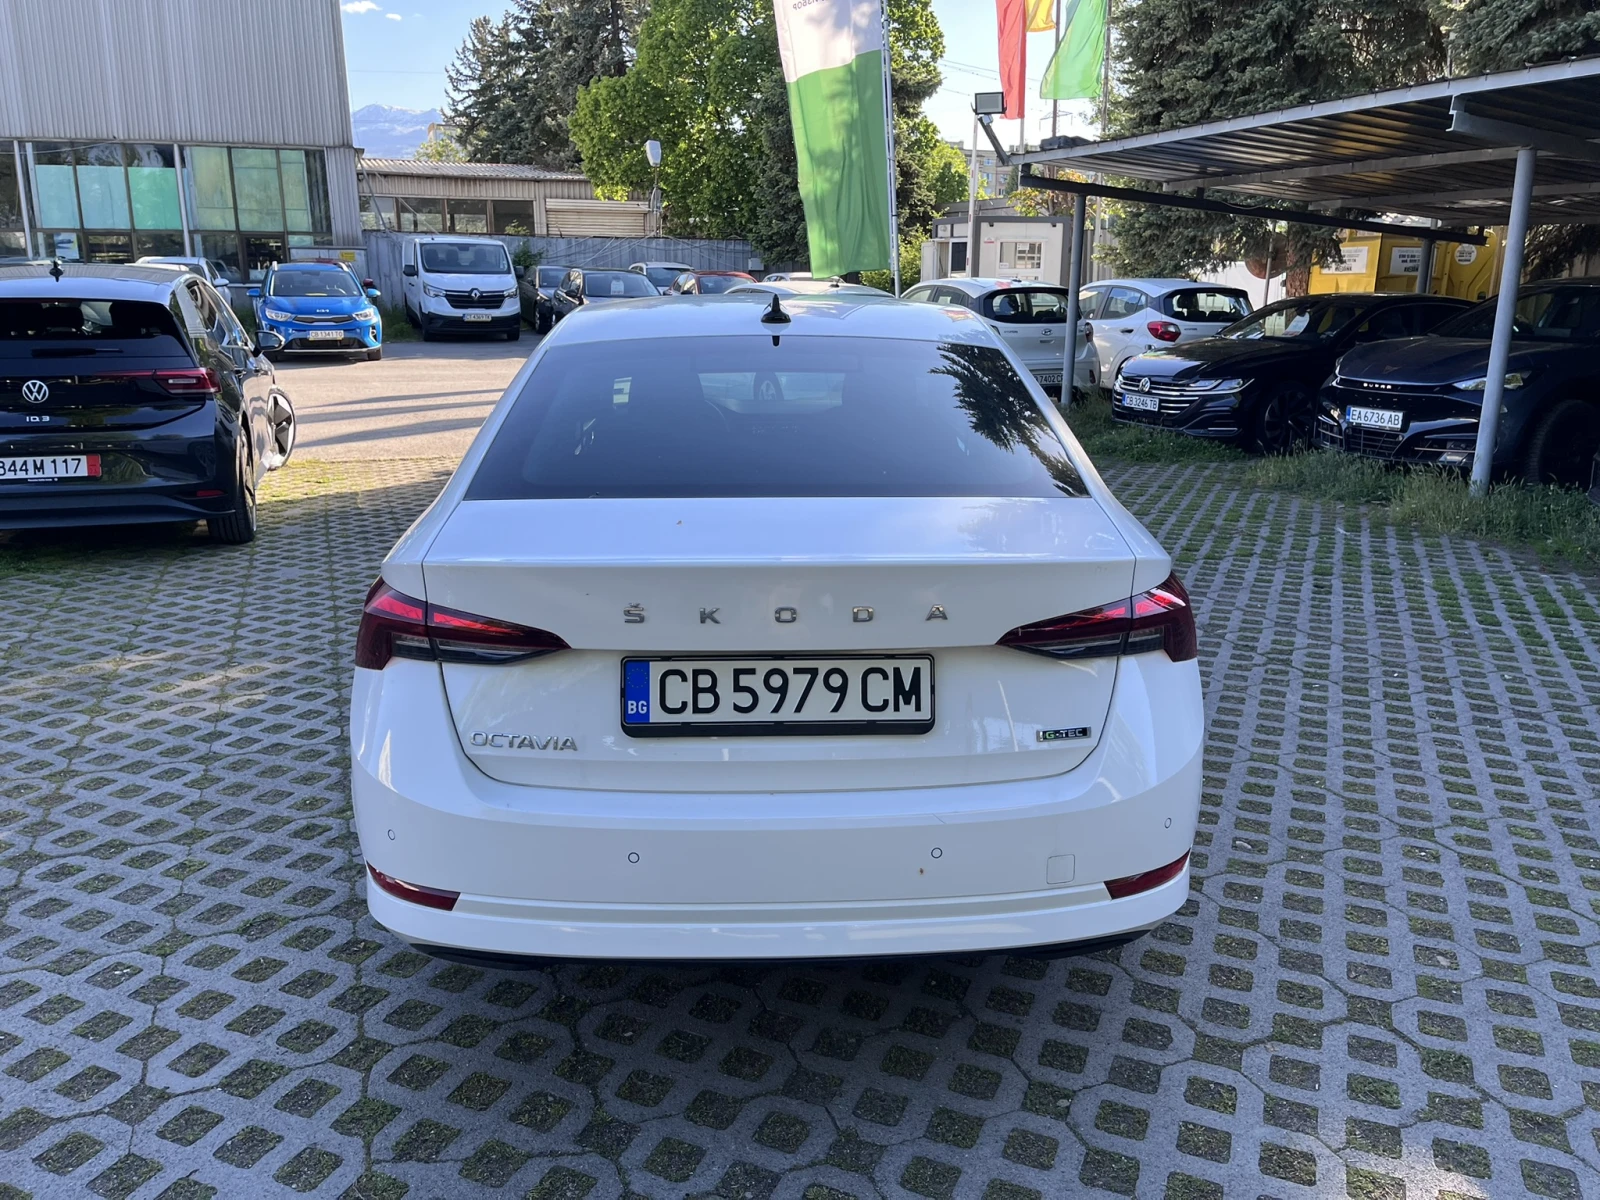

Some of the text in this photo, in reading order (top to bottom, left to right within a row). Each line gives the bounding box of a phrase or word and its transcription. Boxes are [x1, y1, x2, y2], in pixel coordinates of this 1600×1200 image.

[1126, 395, 1158, 409] CB 3246 TB
[1351, 409, 1362, 421] EA
[1363, 411, 1385, 424] 6736
[1387, 414, 1400, 426] AB
[33, 459, 45, 475] M
[51, 458, 81, 474] 117
[623, 602, 948, 624] ŠKODA
[659, 666, 922, 715] CB 5979 CM
[628, 700, 647, 715] BG
[470, 731, 578, 751] OCTAVIA
